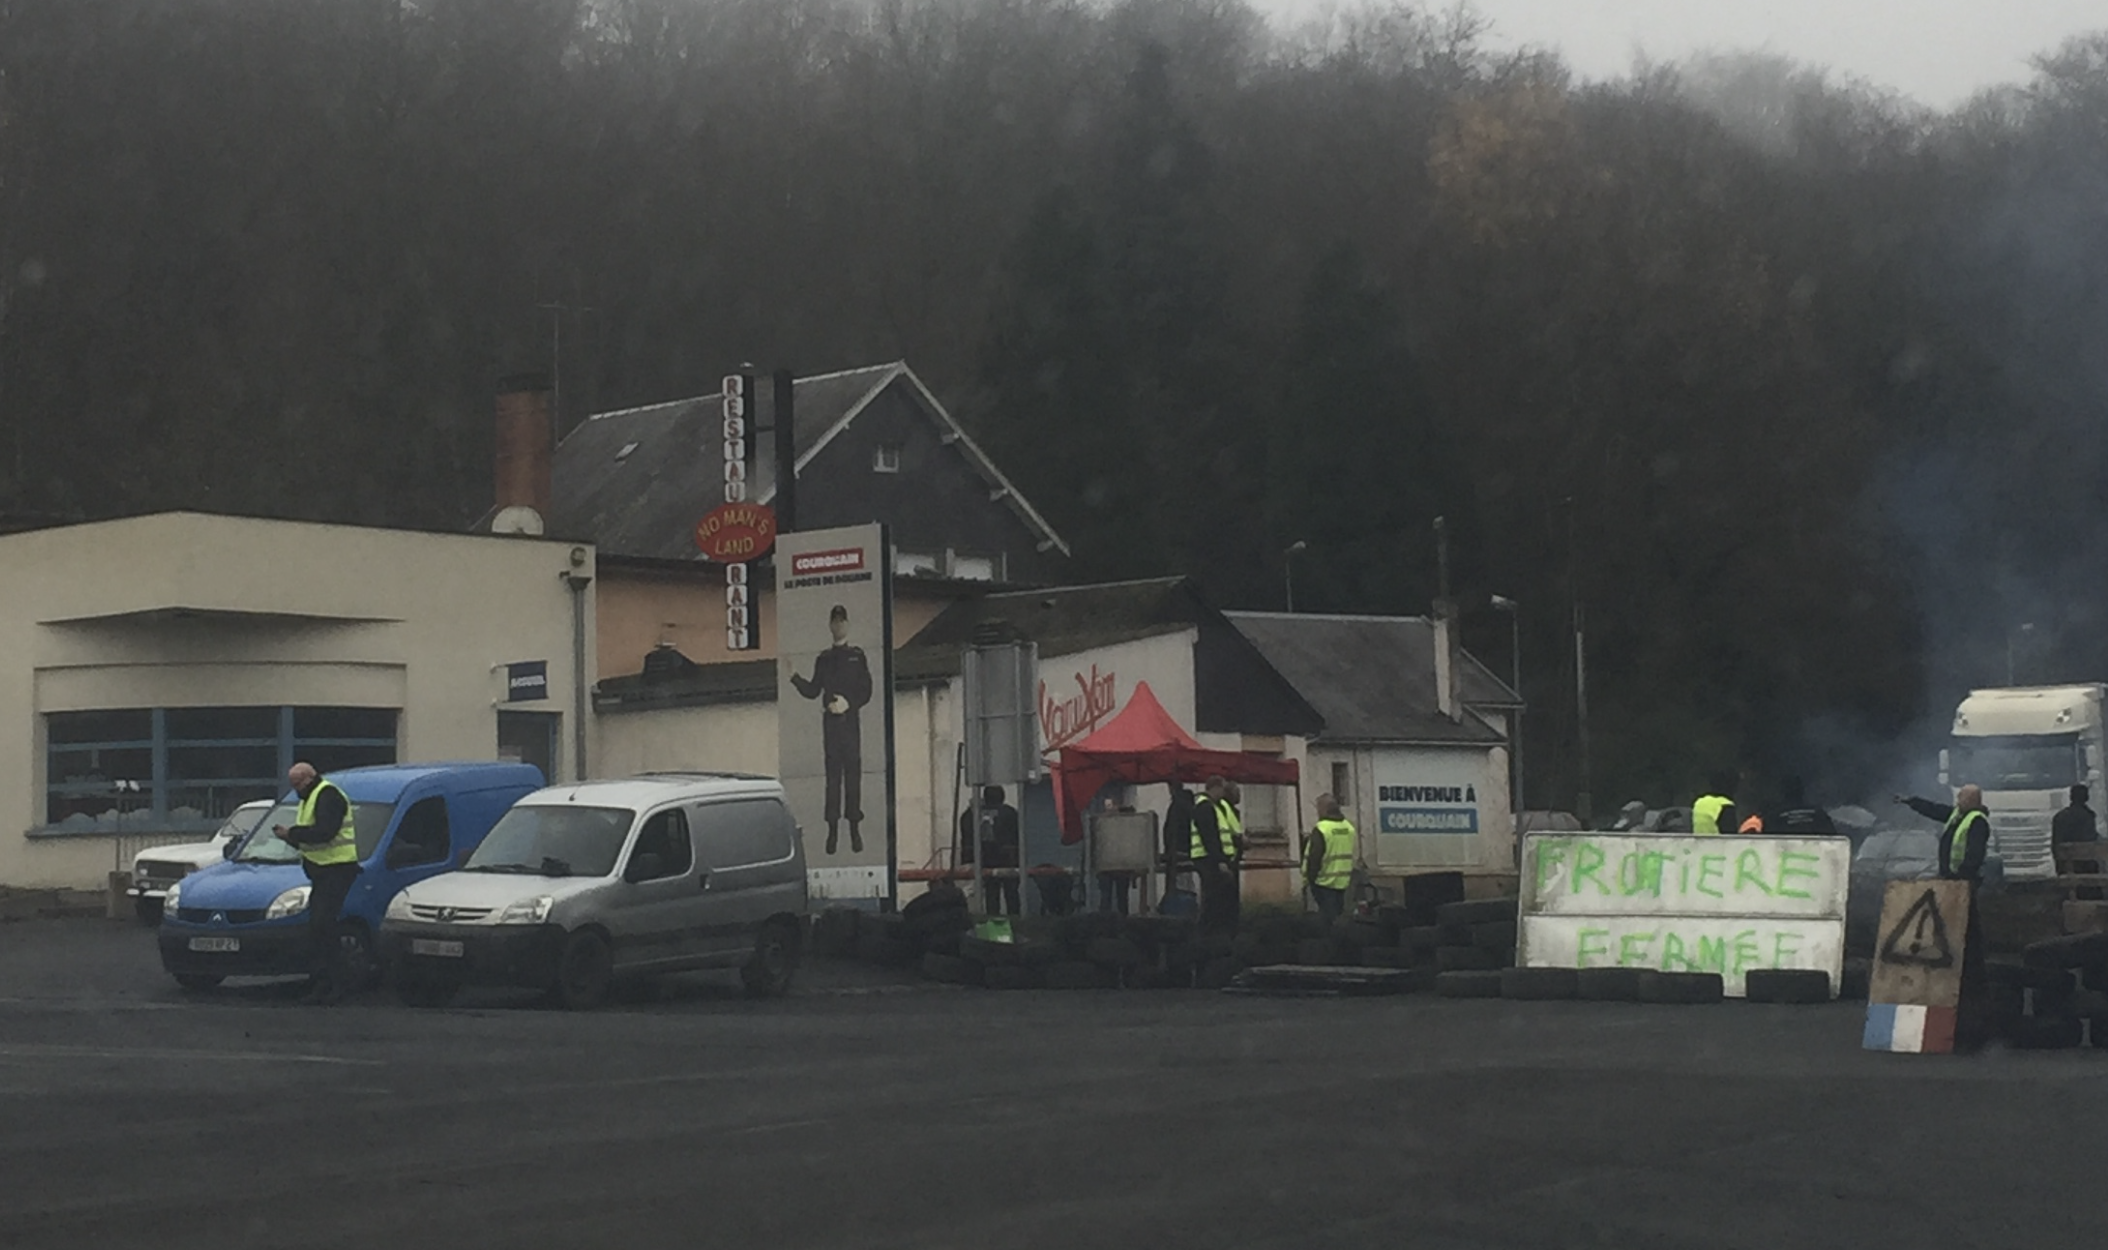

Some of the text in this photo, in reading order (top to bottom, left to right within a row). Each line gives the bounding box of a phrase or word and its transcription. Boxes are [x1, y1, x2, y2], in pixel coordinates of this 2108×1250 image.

[698, 517, 720, 541] NO
[715, 536, 754, 555] LAND
[1379, 786, 1462, 802] BIENVENUE
[1387, 813, 1471, 829] COURQUAIN
